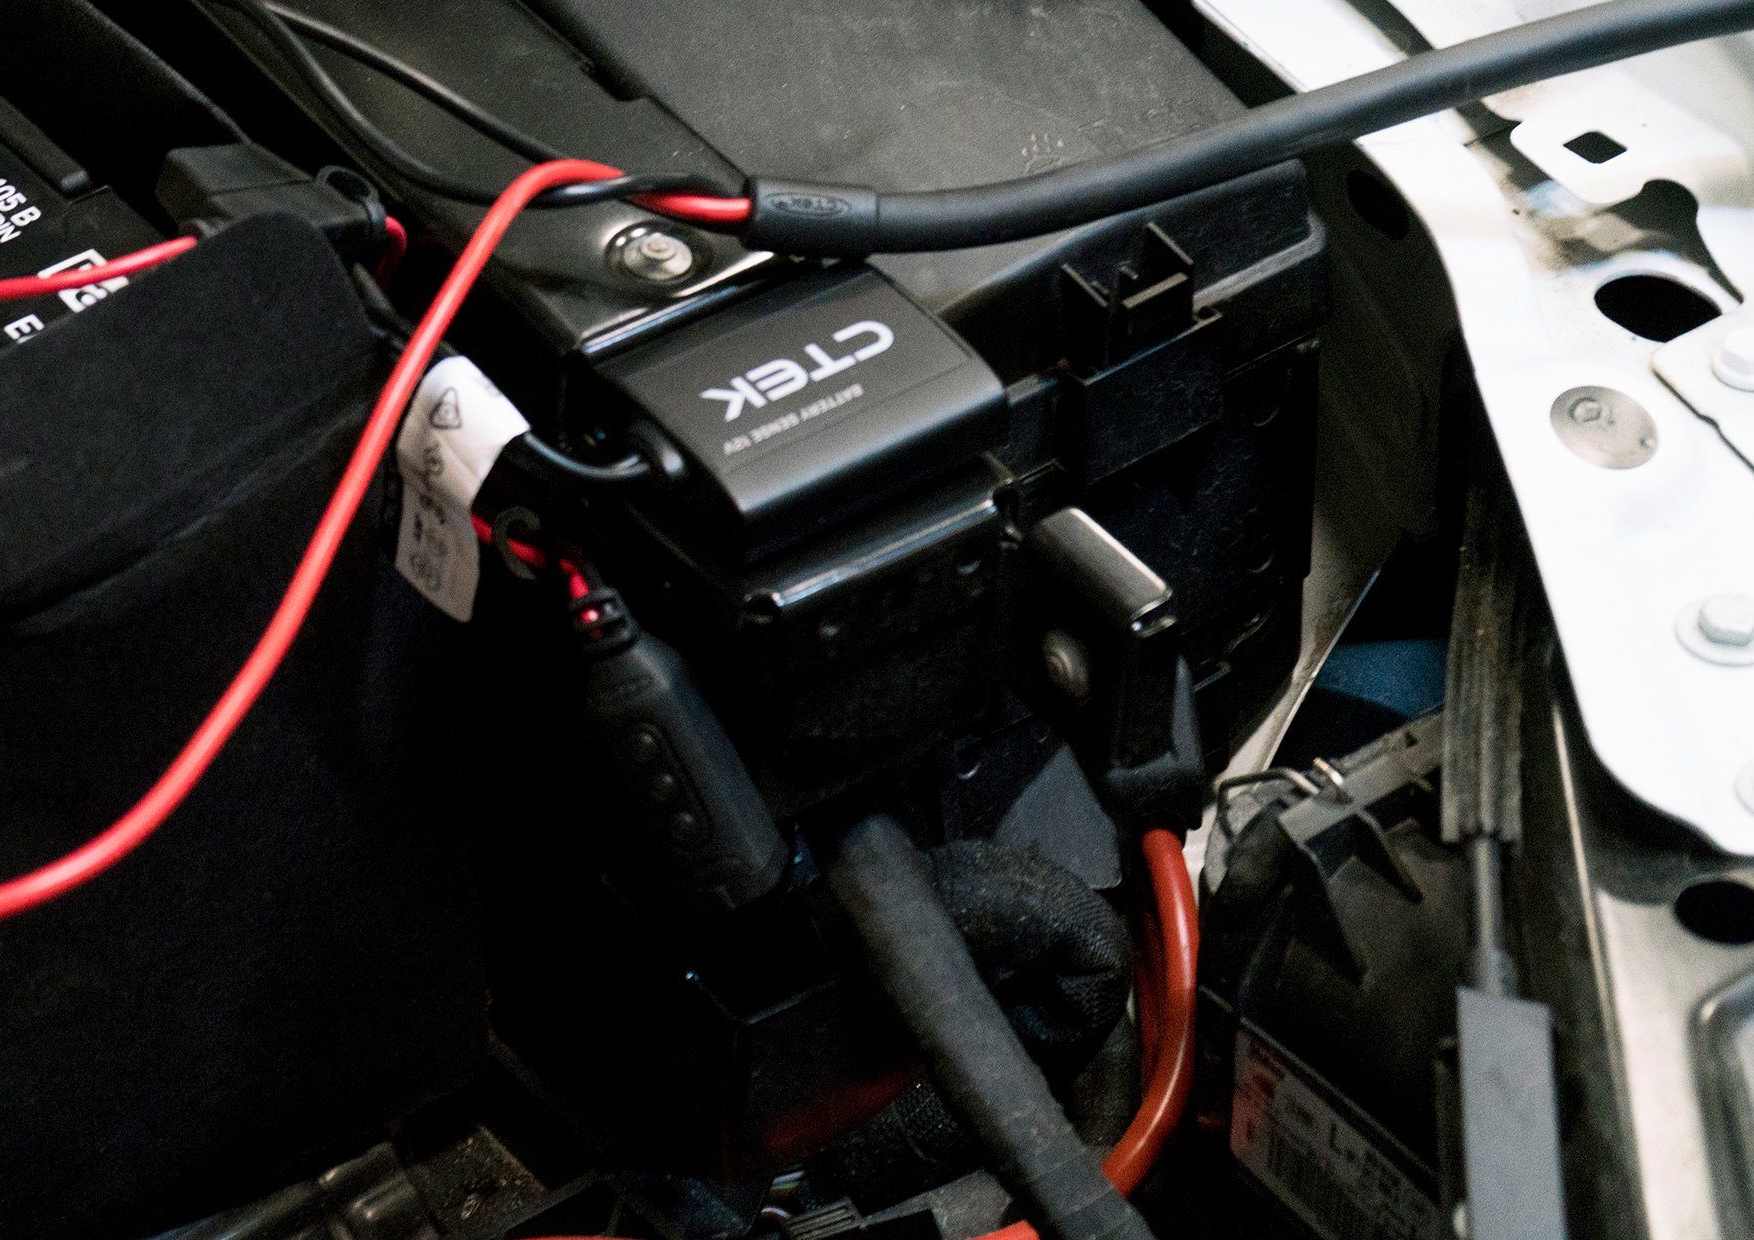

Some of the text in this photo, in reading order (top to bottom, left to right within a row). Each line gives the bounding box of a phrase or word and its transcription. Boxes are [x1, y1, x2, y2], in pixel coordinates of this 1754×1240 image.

[11, 206, 42, 227] B
[699, 320, 895, 422] CTEK
[799, 383, 864, 422] BATTERY
